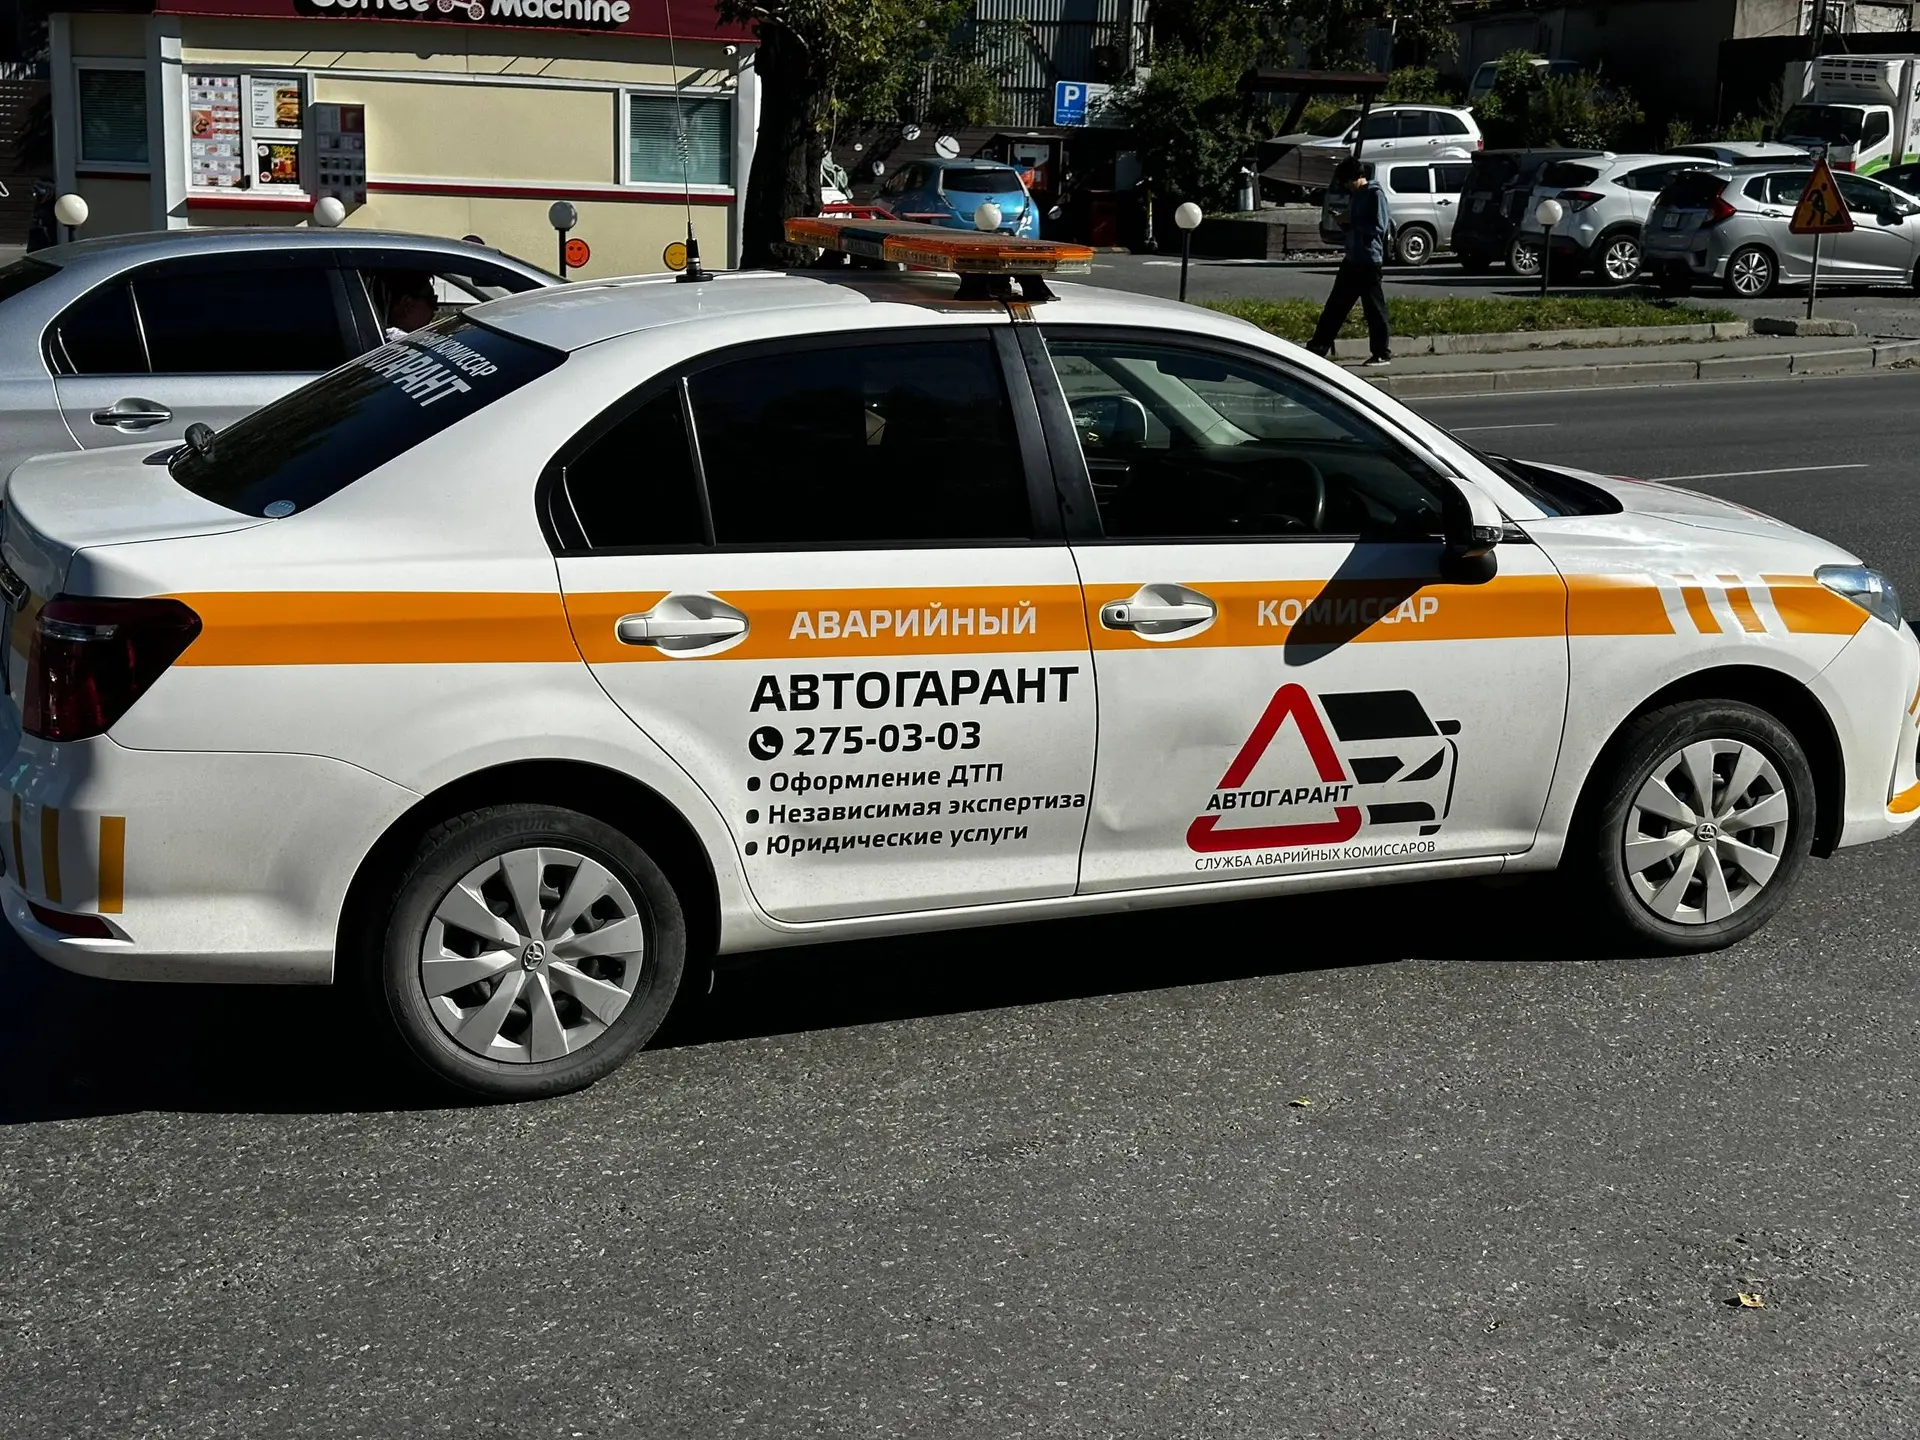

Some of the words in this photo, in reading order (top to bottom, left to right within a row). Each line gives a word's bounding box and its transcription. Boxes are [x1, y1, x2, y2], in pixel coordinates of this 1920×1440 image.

[491, 0, 631, 23] Machine
[1064, 86, 1080, 107] P
[430, 337, 498, 377] КОМИССАР
[788, 600, 1037, 640] АВАРИЙНЫЙ
[1257, 596, 1439, 627] КОМИССАР
[749, 666, 1080, 713] АВТОГАРАНТ
[793, 721, 982, 756] 275-03-03
[769, 771, 941, 795] Оформление
[947, 763, 1004, 789] ДТП
[768, 797, 942, 824] Независимая
[948, 792, 1086, 815] экспертиза
[1205, 785, 1354, 812] АВТОГАРАНТ
[766, 832, 943, 856] Юридические
[950, 824, 1029, 847] услуги
[1194, 853, 1253, 871] СЛУЖБА
[1254, 847, 1341, 866] АВАРИЙНЫХ
[1342, 840, 1436, 860] КОМИССАРОВ
